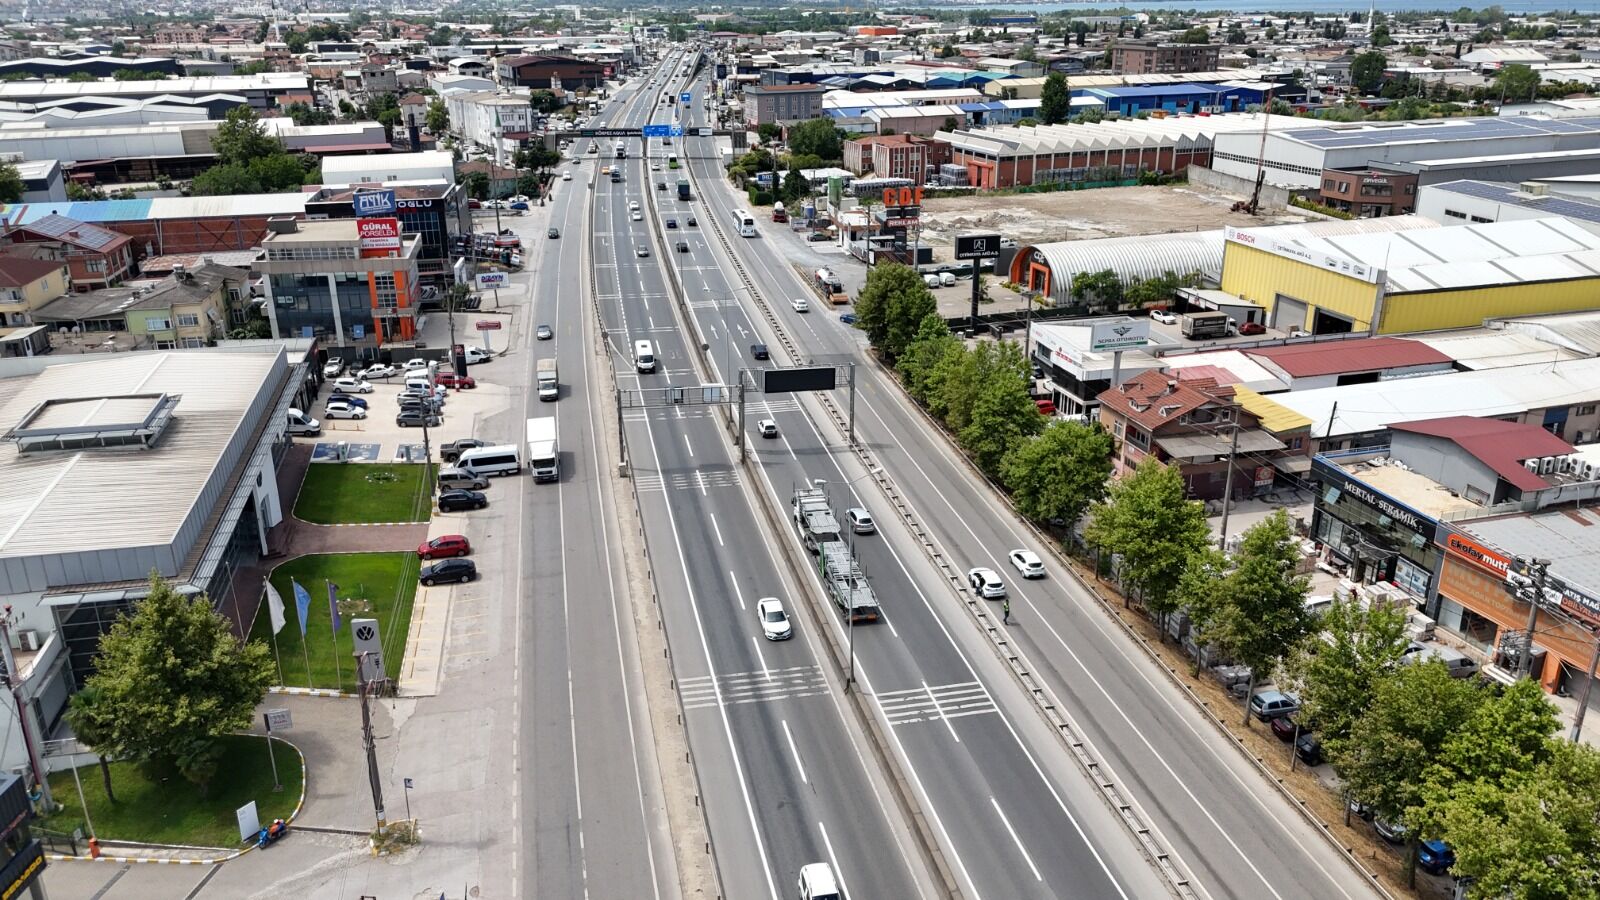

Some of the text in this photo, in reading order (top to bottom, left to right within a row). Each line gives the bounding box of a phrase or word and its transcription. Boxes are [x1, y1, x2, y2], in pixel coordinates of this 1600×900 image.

[362, 222, 392, 231] GÜRAL
[1236, 232, 1255, 244] BOSCH
[1343, 481, 1377, 505] MERTAL
[1378, 500, 1418, 528] SERAMİK
